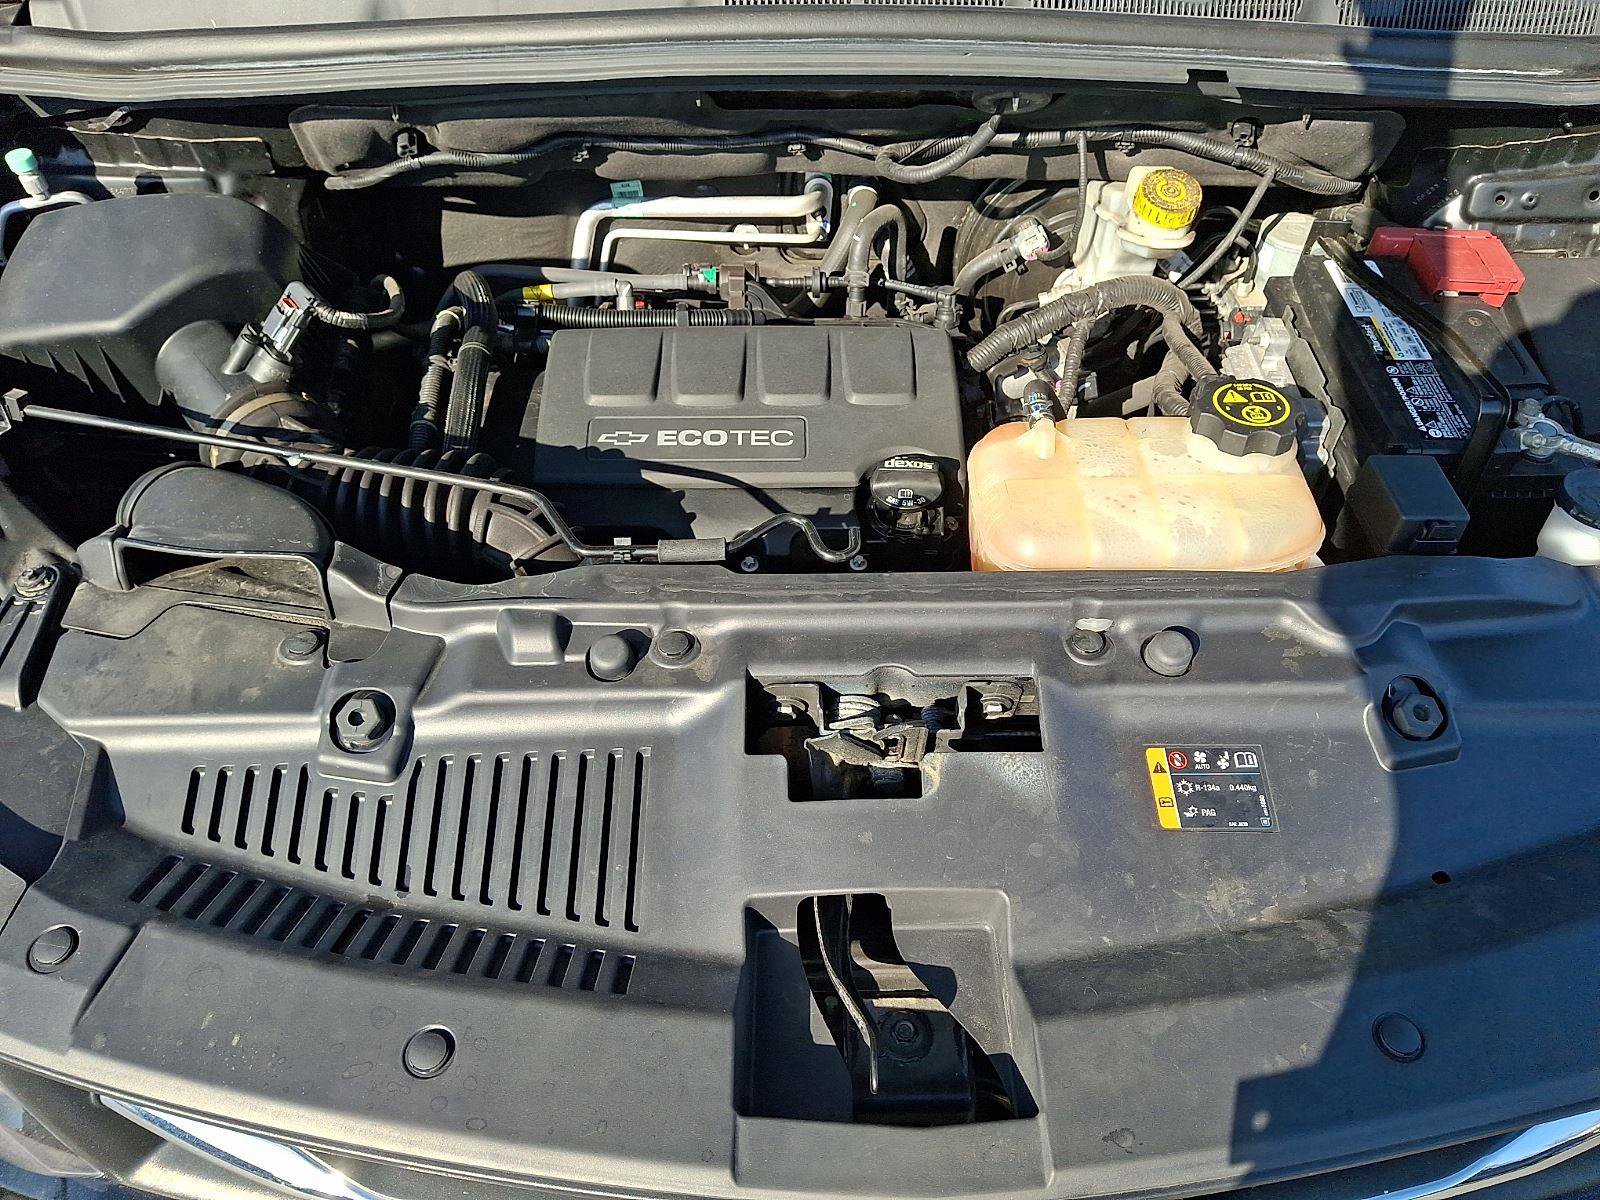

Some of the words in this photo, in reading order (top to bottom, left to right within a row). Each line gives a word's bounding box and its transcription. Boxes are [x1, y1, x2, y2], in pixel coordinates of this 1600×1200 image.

[657, 429, 795, 447] ECOTEC
[884, 457, 934, 470] dexos
[902, 496, 926, 507] 5W-30
[1195, 784, 1220, 792] R-134a
[1201, 808, 1217, 817] PAG
